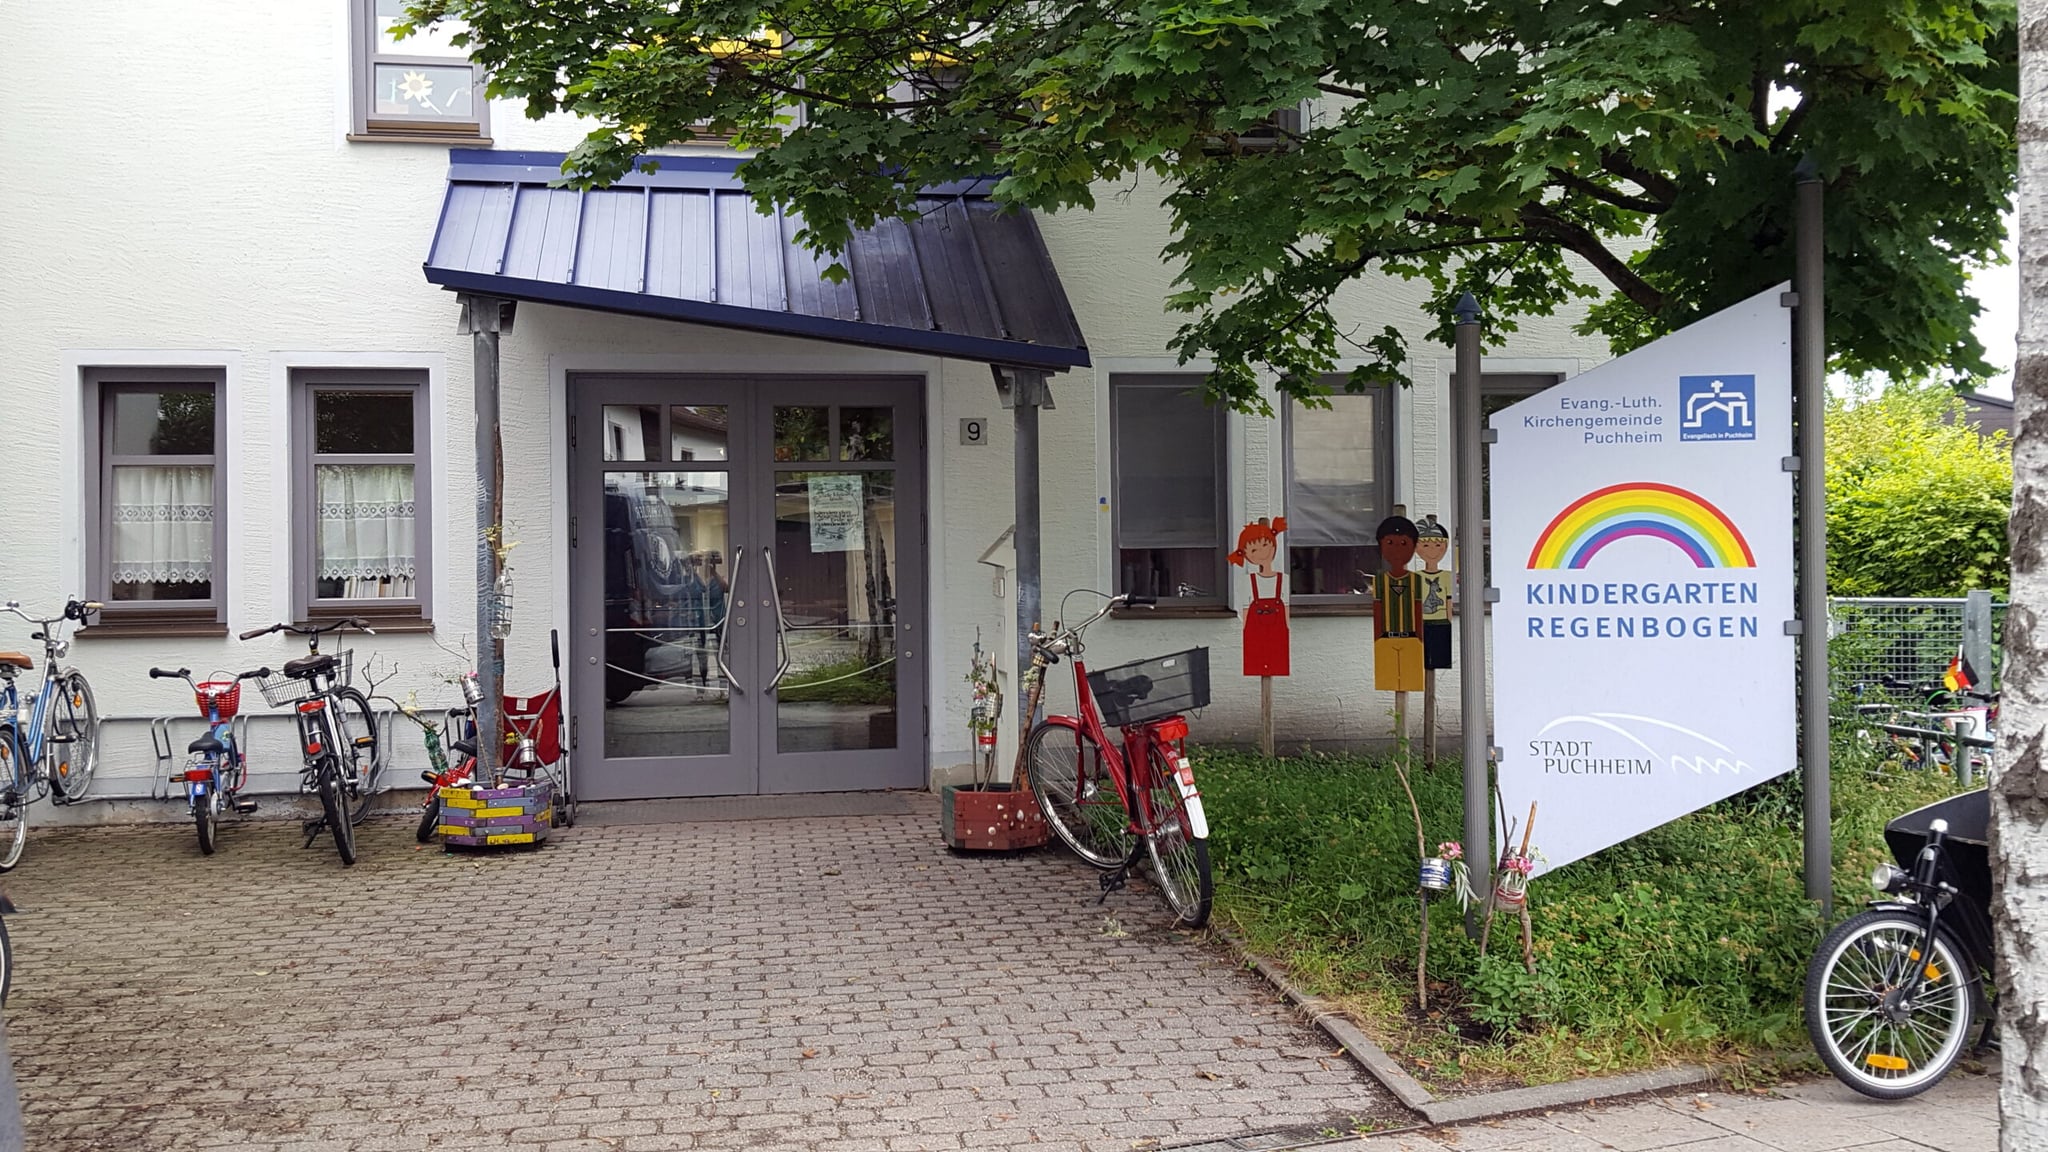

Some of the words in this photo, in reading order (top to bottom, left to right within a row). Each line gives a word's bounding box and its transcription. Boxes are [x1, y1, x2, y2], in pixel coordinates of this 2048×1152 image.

[1560, 397, 1662, 411] Evang.-Luth.
[1524, 414, 1662, 429] Kirchengemeinde
[967, 422, 980, 441] 9
[1584, 431, 1662, 444] Puchheim
[1526, 583, 1758, 605] KINDERGARTEN
[1527, 616, 1758, 638] REGENBOGEN
[1529, 741, 1593, 757] STADT
[1544, 759, 1652, 775] PUCHHEIM
